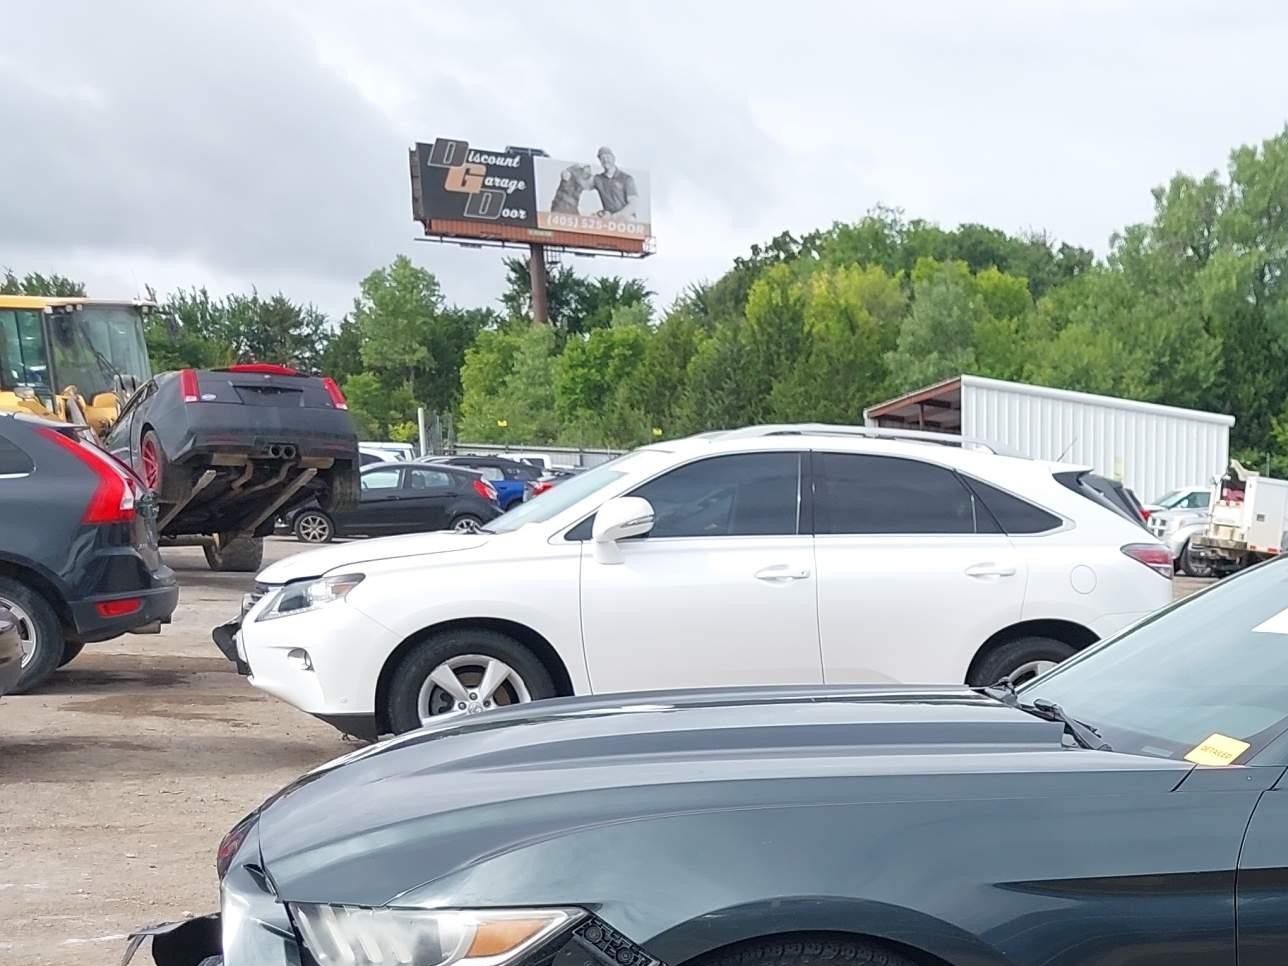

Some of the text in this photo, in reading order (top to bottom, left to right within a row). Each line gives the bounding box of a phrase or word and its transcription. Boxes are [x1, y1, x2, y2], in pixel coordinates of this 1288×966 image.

[427, 138, 521, 168] Discount
[444, 163, 527, 193] Garage
[464, 189, 528, 220] Door
